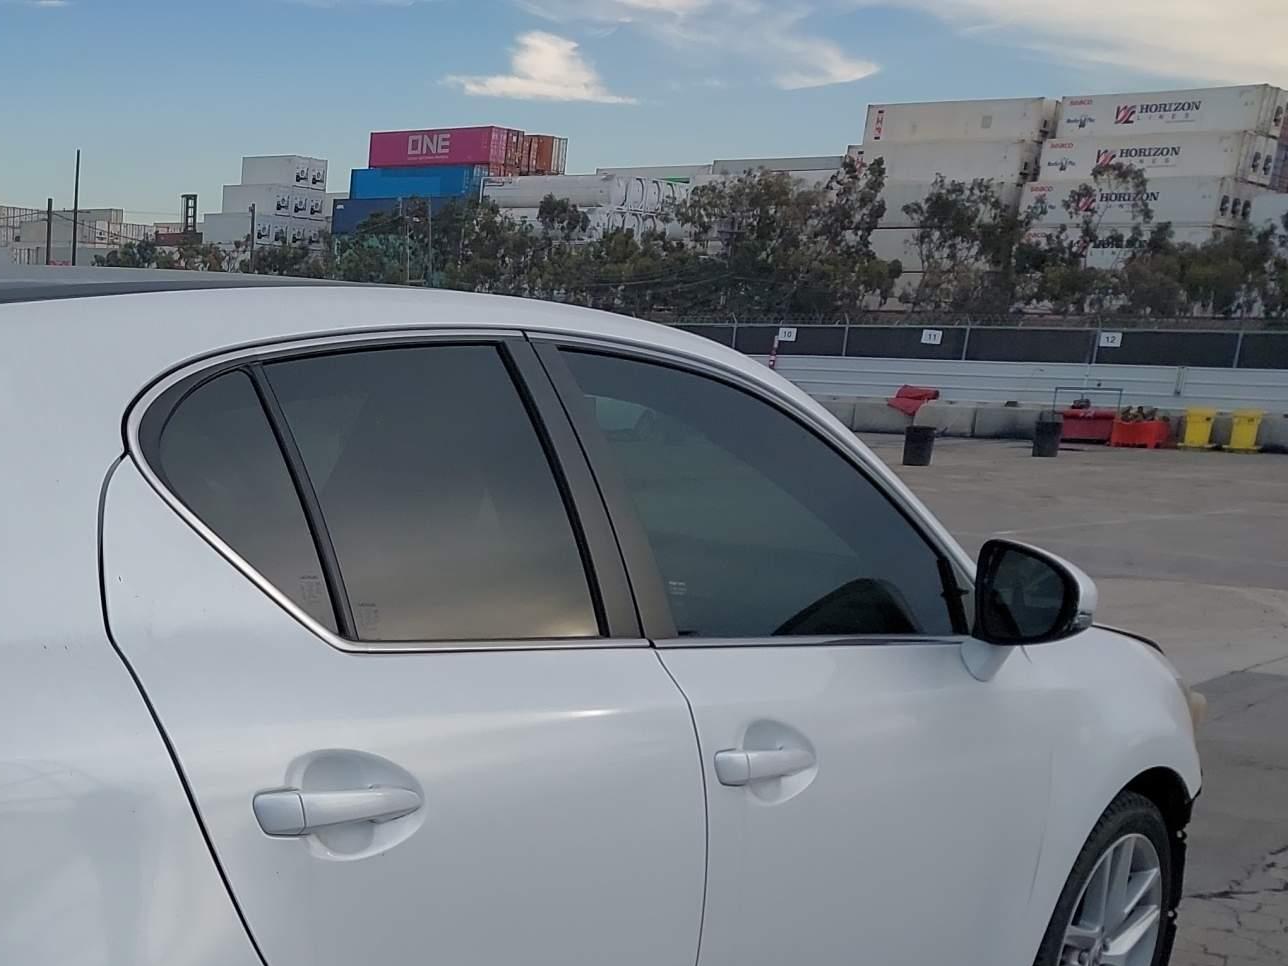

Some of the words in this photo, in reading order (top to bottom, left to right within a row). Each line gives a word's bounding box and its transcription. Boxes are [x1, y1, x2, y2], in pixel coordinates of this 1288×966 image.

[1138, 100, 1202, 114] HORIZON
[1137, 112, 1190, 121] LINES
[407, 133, 450, 155] ONE
[1119, 146, 1181, 158] HORIZON
[1099, 191, 1160, 202] HORIZON
[782, 330, 792, 338] 10
[1105, 335, 1117, 343] 12
